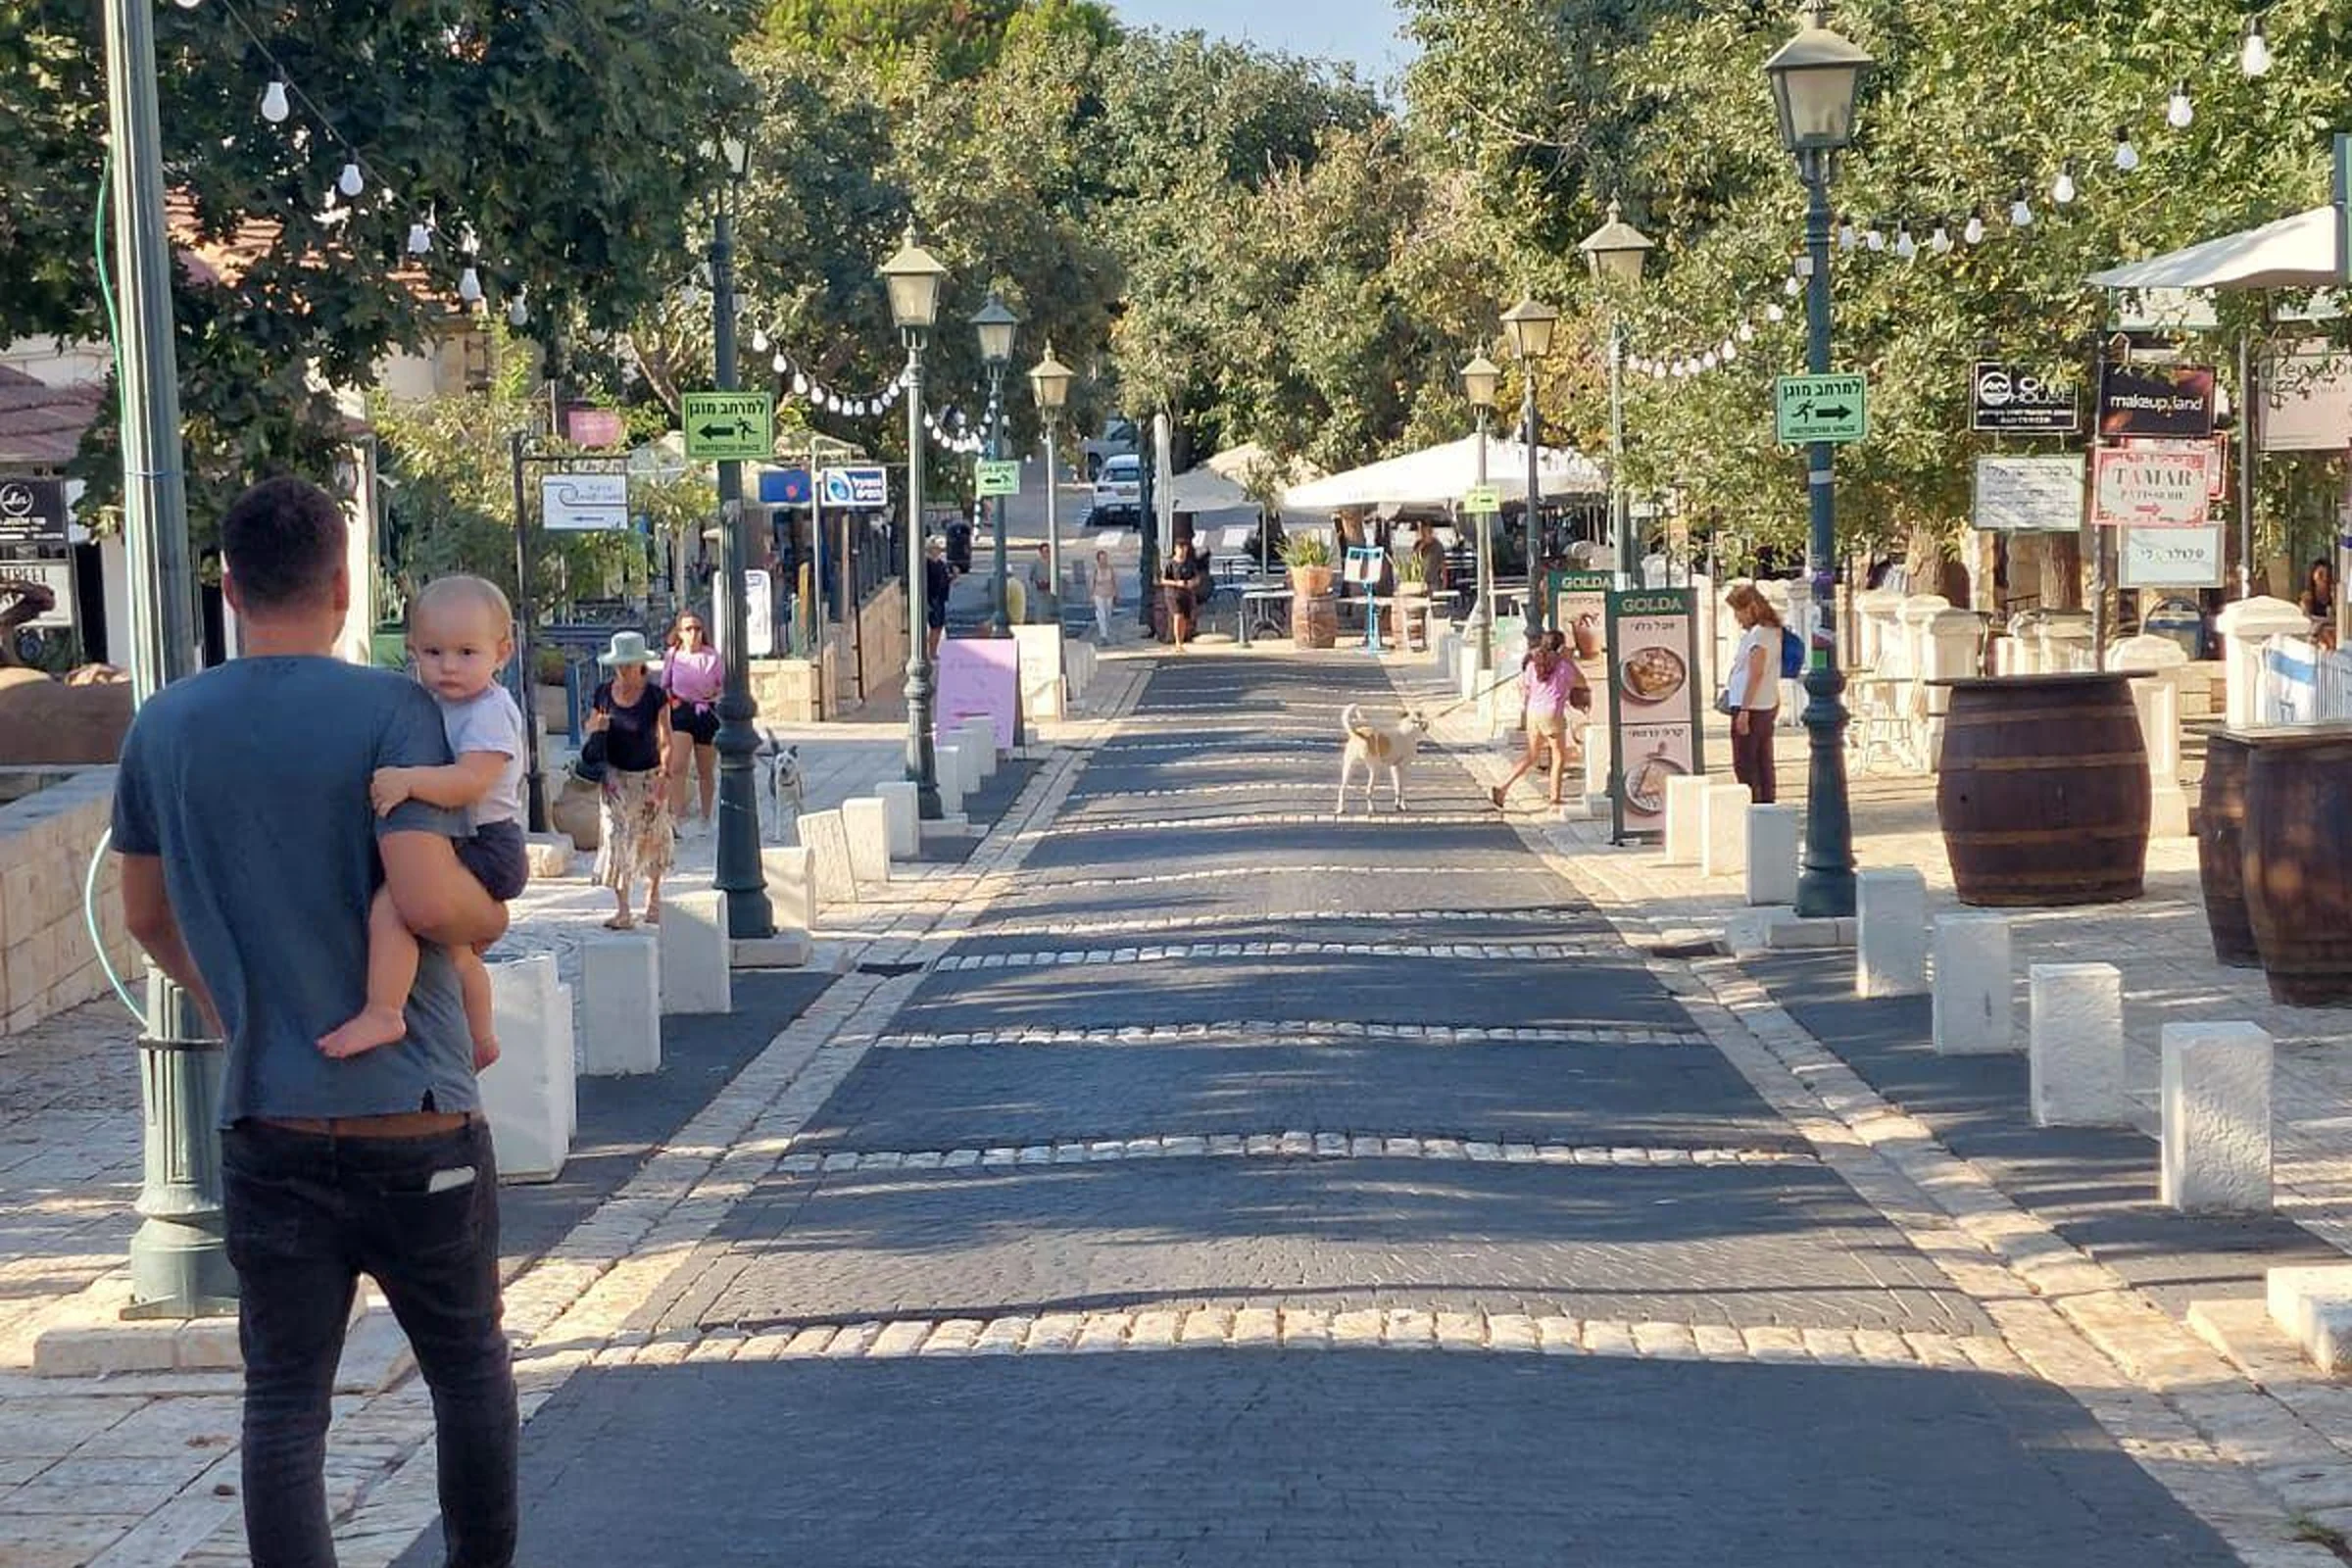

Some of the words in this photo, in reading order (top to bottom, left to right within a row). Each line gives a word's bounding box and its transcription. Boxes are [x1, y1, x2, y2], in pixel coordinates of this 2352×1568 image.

[1784, 385, 1811, 401] מוגן
[1815, 380, 1860, 396] למרחב
[689, 403, 716, 418] מוגן
[719, 399, 764, 415] למרחב
[2113, 467, 2193, 487] TAMAR
[1561, 576, 1613, 590] GOLDA
[1622, 597, 1683, 612] GOLDA
